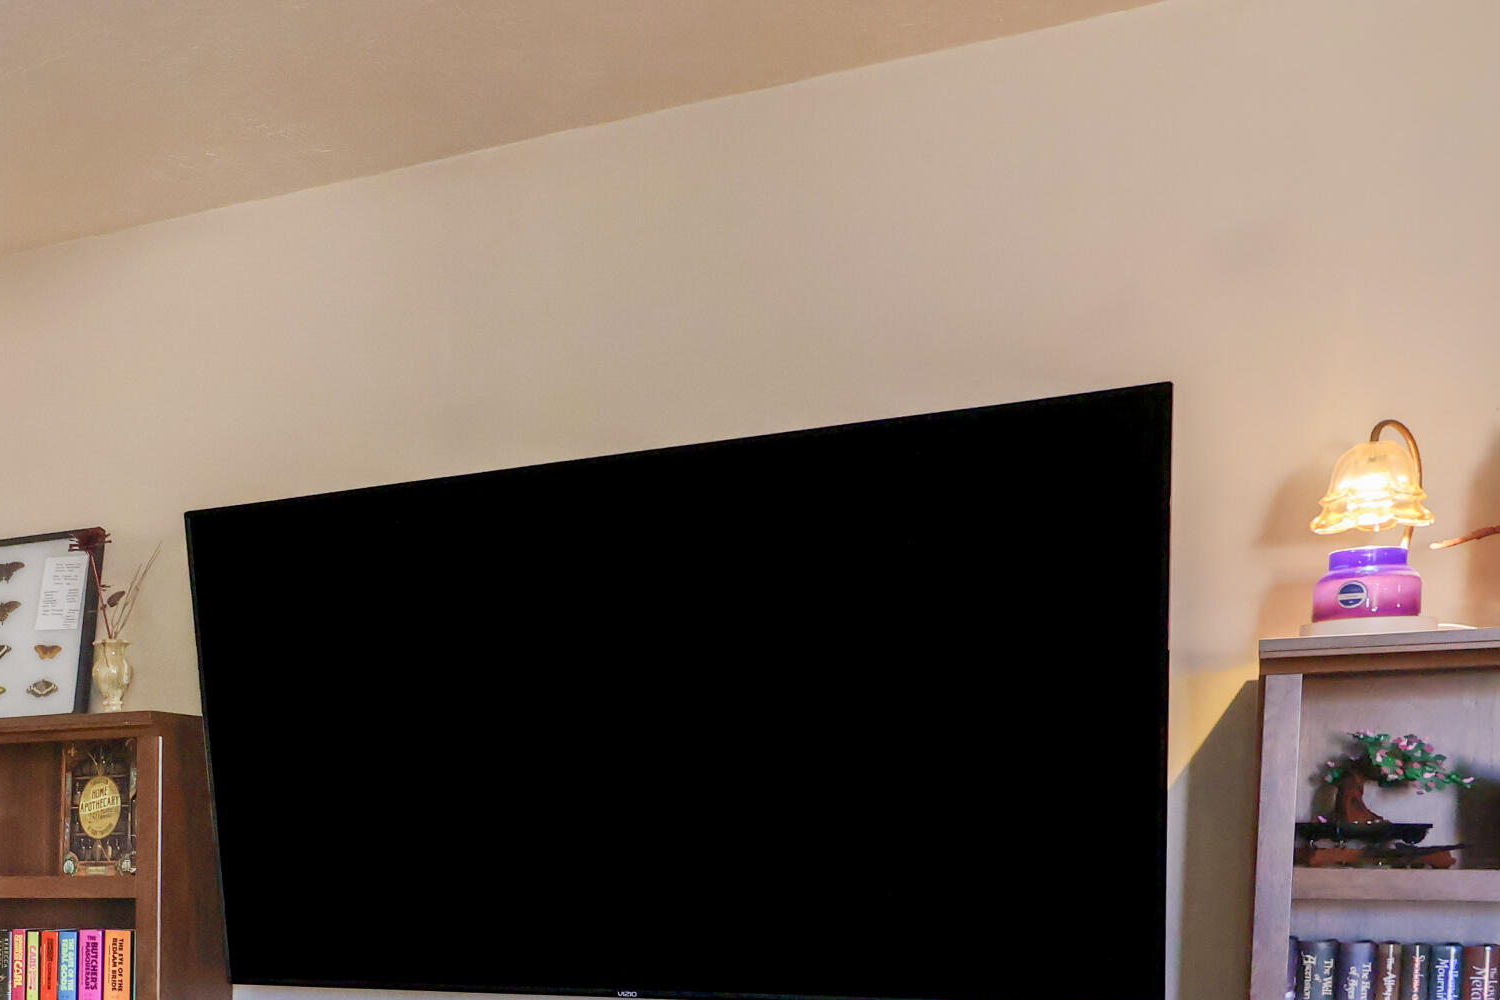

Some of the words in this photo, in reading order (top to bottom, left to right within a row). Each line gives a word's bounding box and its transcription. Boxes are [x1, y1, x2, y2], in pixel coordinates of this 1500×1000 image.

[80, 795, 120, 812] APOTHECARY
[118, 968, 124, 977] OF
[1301, 951, 1317, 1000] Ascension
[1323, 958, 1334, 976] The
[1348, 966, 1359, 976] of
[1362, 962, 1372, 980] The
[1321, 976, 1333, 996] Well
[1343, 977, 1358, 1000] Ages
